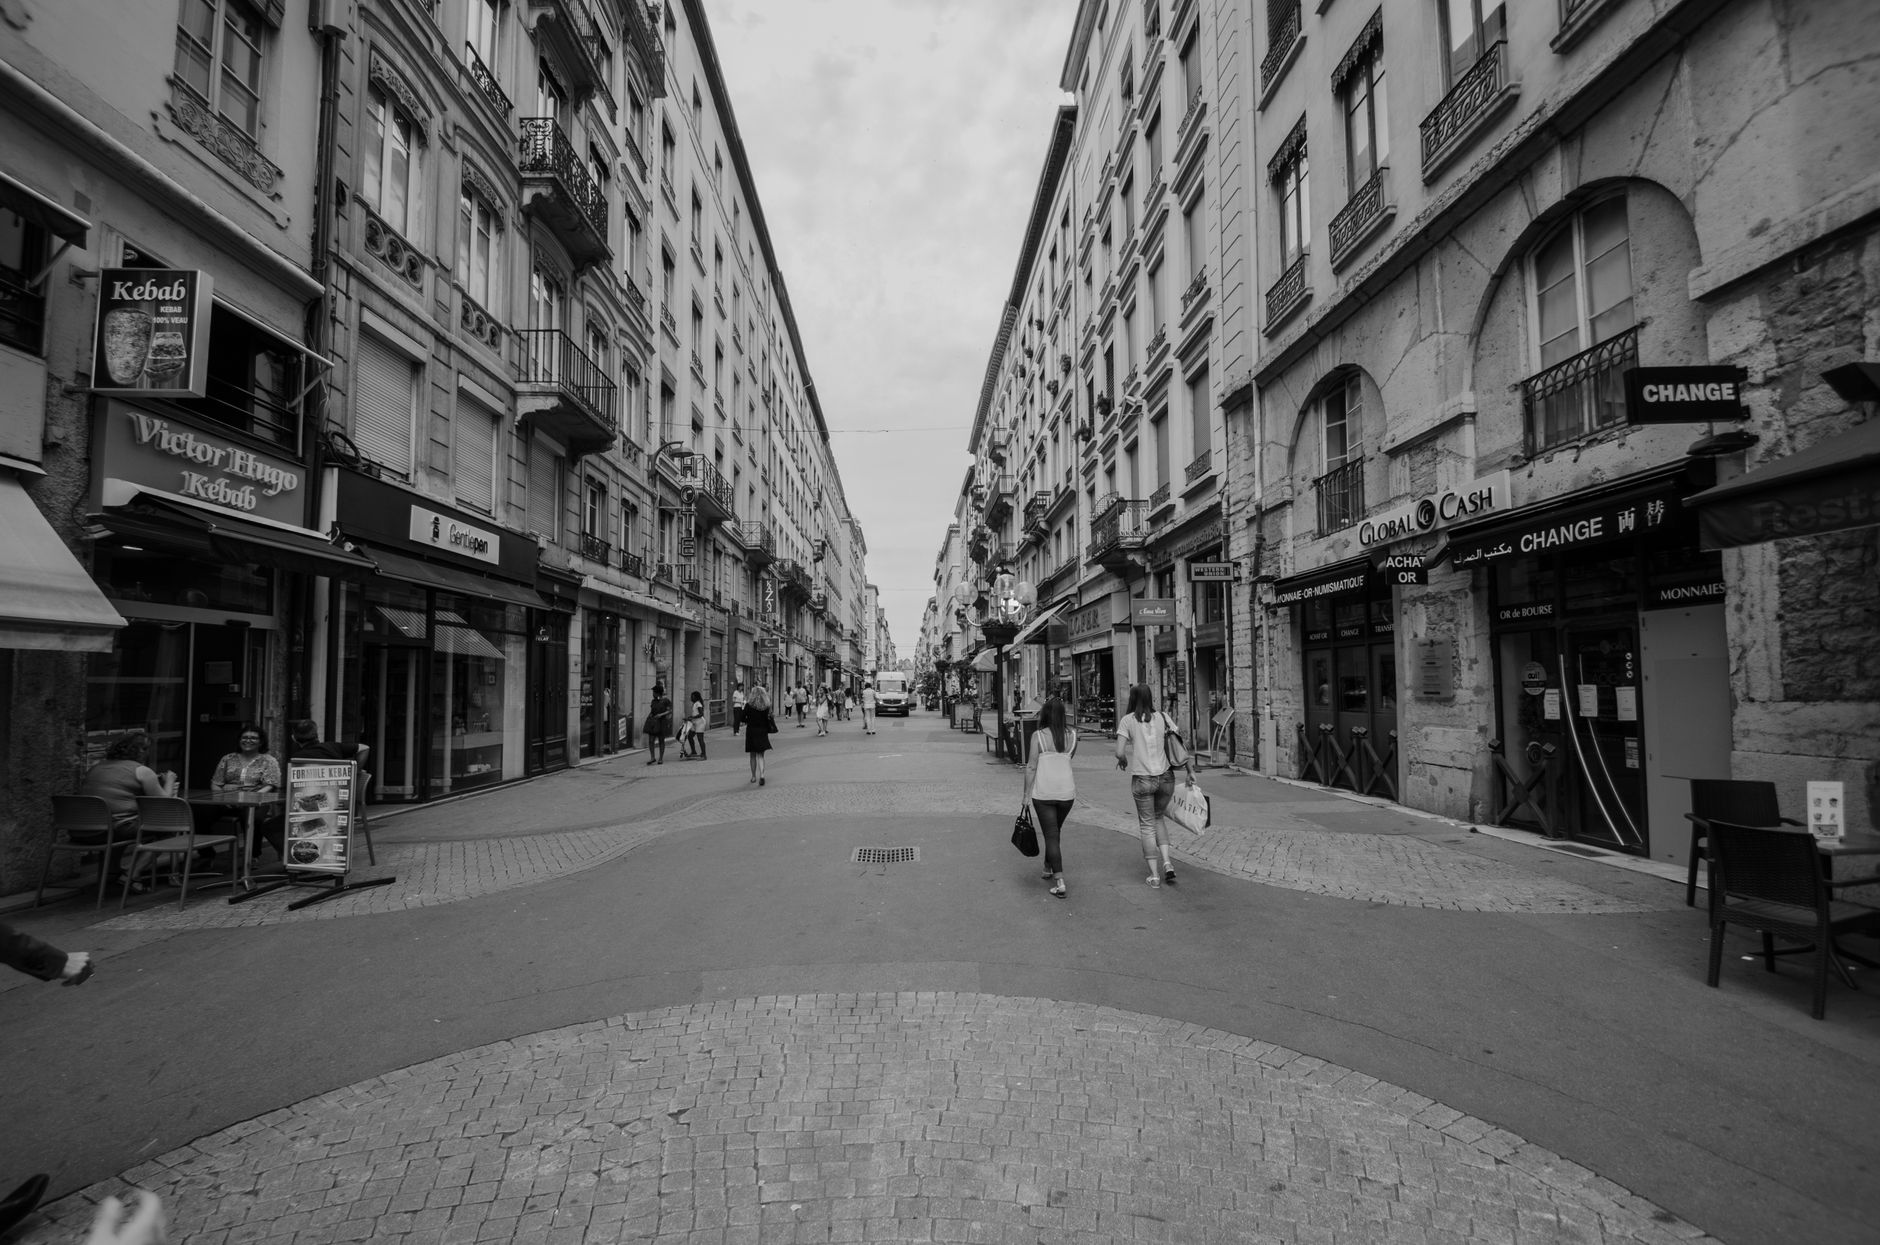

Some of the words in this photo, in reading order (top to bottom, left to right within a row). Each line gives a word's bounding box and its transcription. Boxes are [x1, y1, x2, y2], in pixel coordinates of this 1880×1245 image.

[111, 279, 186, 301] Kebab
[1642, 382, 1736, 403] CHANGE
[127, 412, 225, 467] Victor
[222, 447, 298, 497] Hugo
[180, 471, 257, 511] Kebab
[681, 455, 695, 583] HOTEL
[1520, 516, 1603, 552] CHANGE
[1386, 556, 1427, 568] ACHAT
[1398, 572, 1417, 583] OR
[1661, 582, 1726, 601] MONNAIES
[1500, 609, 1511, 619] OR
[1512, 609, 1520, 619] de
[1522, 604, 1552, 617] BOURSE
[1309, 632, 1321, 640] ACHAT
[1341, 628, 1359, 637] CHANGE
[292, 768, 326, 780] FORMULE
